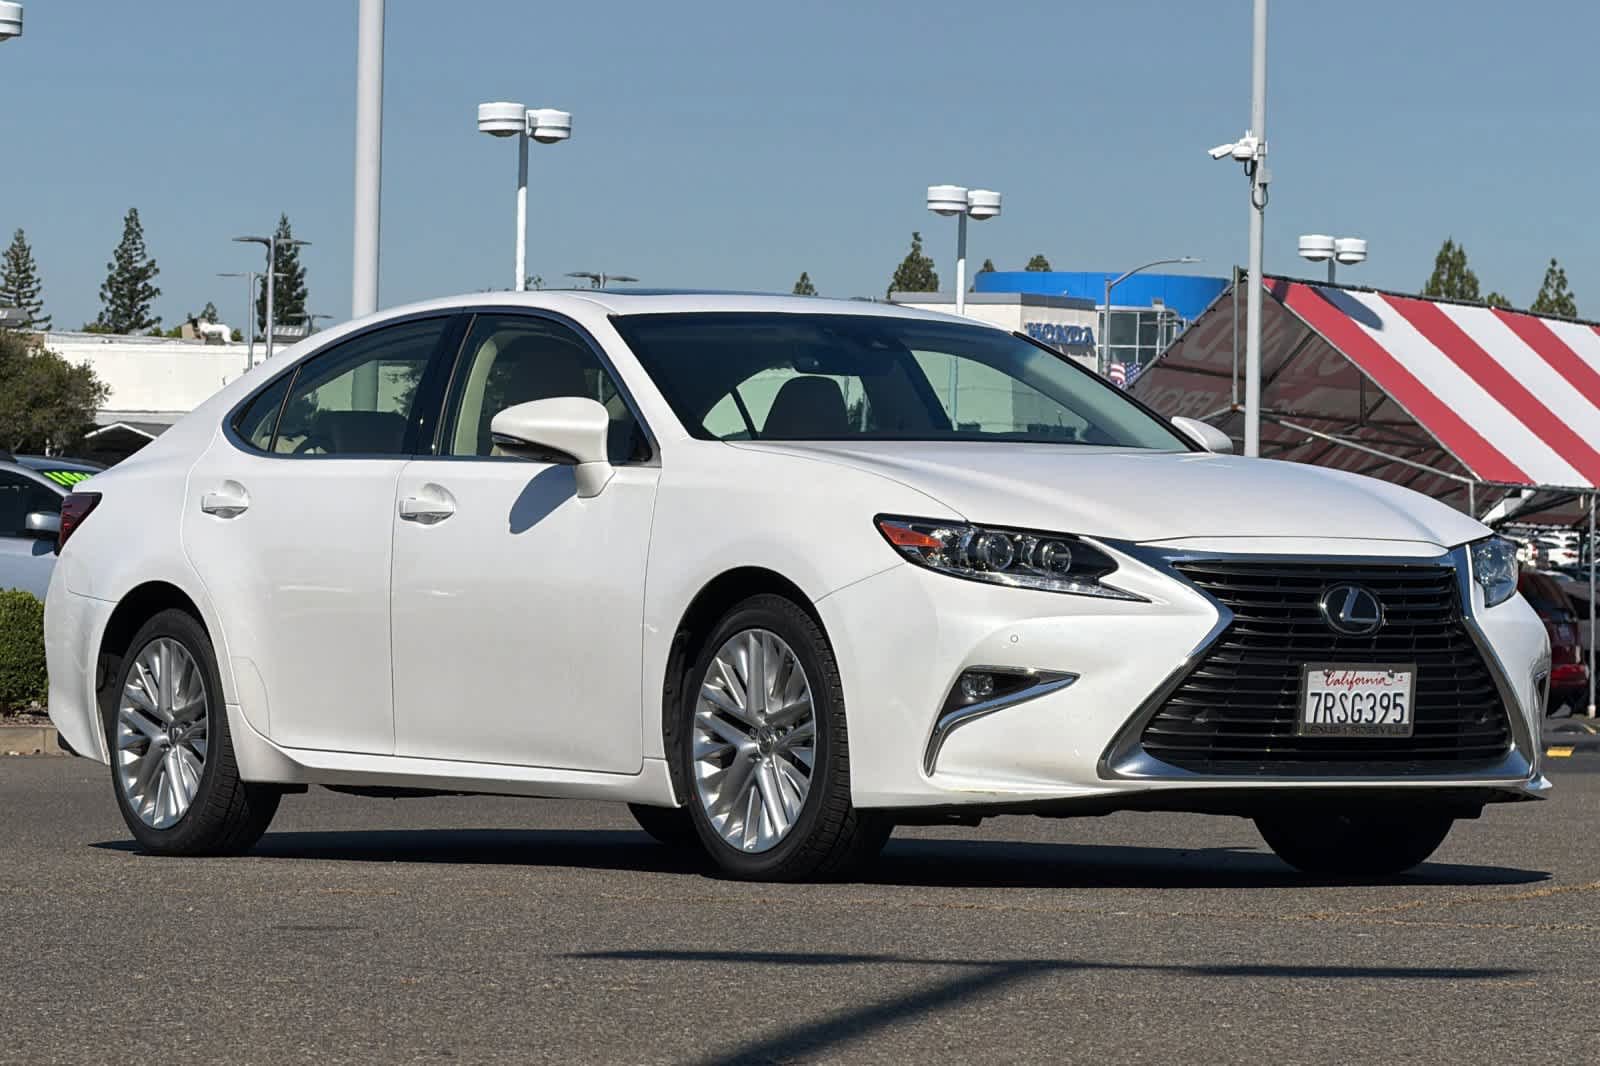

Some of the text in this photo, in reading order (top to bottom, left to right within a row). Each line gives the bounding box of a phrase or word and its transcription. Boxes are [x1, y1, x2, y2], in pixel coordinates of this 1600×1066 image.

[1026, 322, 1096, 345] HONDA
[1325, 671, 1393, 691] California
[1310, 692, 1405, 724] 7RSG395
